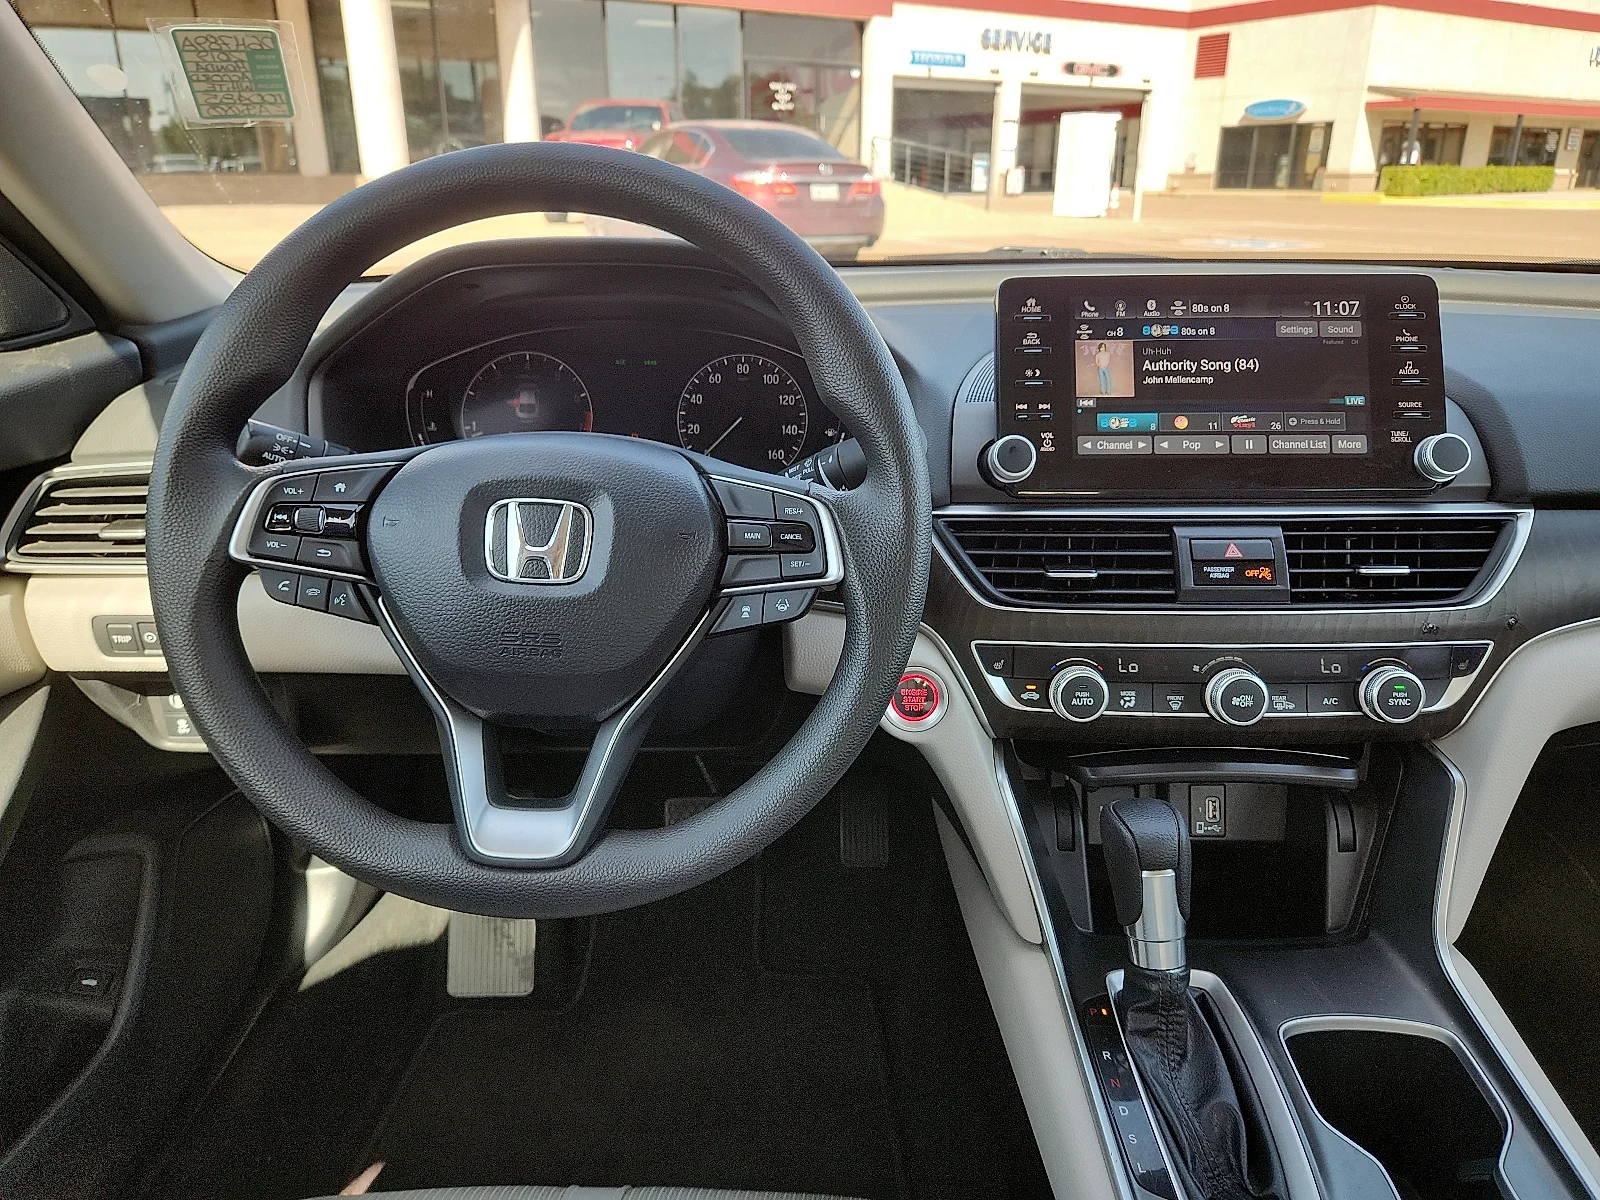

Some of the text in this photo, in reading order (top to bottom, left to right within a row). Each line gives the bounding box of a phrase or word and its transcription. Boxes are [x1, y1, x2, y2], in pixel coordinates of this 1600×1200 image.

[1192, 303, 1230, 314] 80s on 8
[1312, 301, 1360, 316] 11:07
[1116, 327, 1124, 337] 8
[1181, 327, 1196, 336] 80s
[1209, 327, 1216, 335] 8
[1280, 325, 1313, 335] Settings
[1327, 325, 1353, 334] Sound
[1142, 347, 1172, 356] Uh-Huh
[736, 364, 750, 375] 80
[1142, 359, 1259, 374] Authority Song (84)
[708, 373, 722, 384] 60
[762, 374, 779, 385] 100
[1142, 375, 1214, 386] John Mellencamp
[689, 394, 703, 405] 40
[778, 395, 795, 406] 120
[1346, 397, 1363, 405] LIVE
[1208, 422, 1218, 430] 11
[1270, 422, 1282, 430] 26
[1300, 417, 1318, 426] Press
[1327, 417, 1341, 426] Hold
[687, 423, 700, 435] 20
[781, 425, 798, 436] 140
[1150, 423, 1156, 431] 8
[276, 433, 294, 443] OFF
[1097, 440, 1133, 450] Channel
[1182, 440, 1201, 452] Pop
[1272, 440, 1327, 450] Channel List
[1338, 440, 1362, 450] More
[767, 450, 785, 461] 160
[784, 507, 804, 516] RES/+
[744, 532, 761, 540] MAIN
[780, 533, 803, 541] CANCEL
[1245, 569, 1260, 577] OFF
[110, 635, 132, 644] TRIP
[1118, 658, 1139, 673] Lo
[1321, 658, 1342, 673] Lo
[900, 688, 928, 696] ENGINE
[1071, 697, 1094, 706] AUTO
[1240, 700, 1254, 708] OFF
[1322, 697, 1338, 706] A/C
[1387, 698, 1411, 706] SYNC
[1102, 1051, 1112, 1061] R
[1110, 1078, 1121, 1088] N
[1118, 1105, 1128, 1116] D
[1128, 1133, 1138, 1145] S
[1136, 1162, 1147, 1174] L
